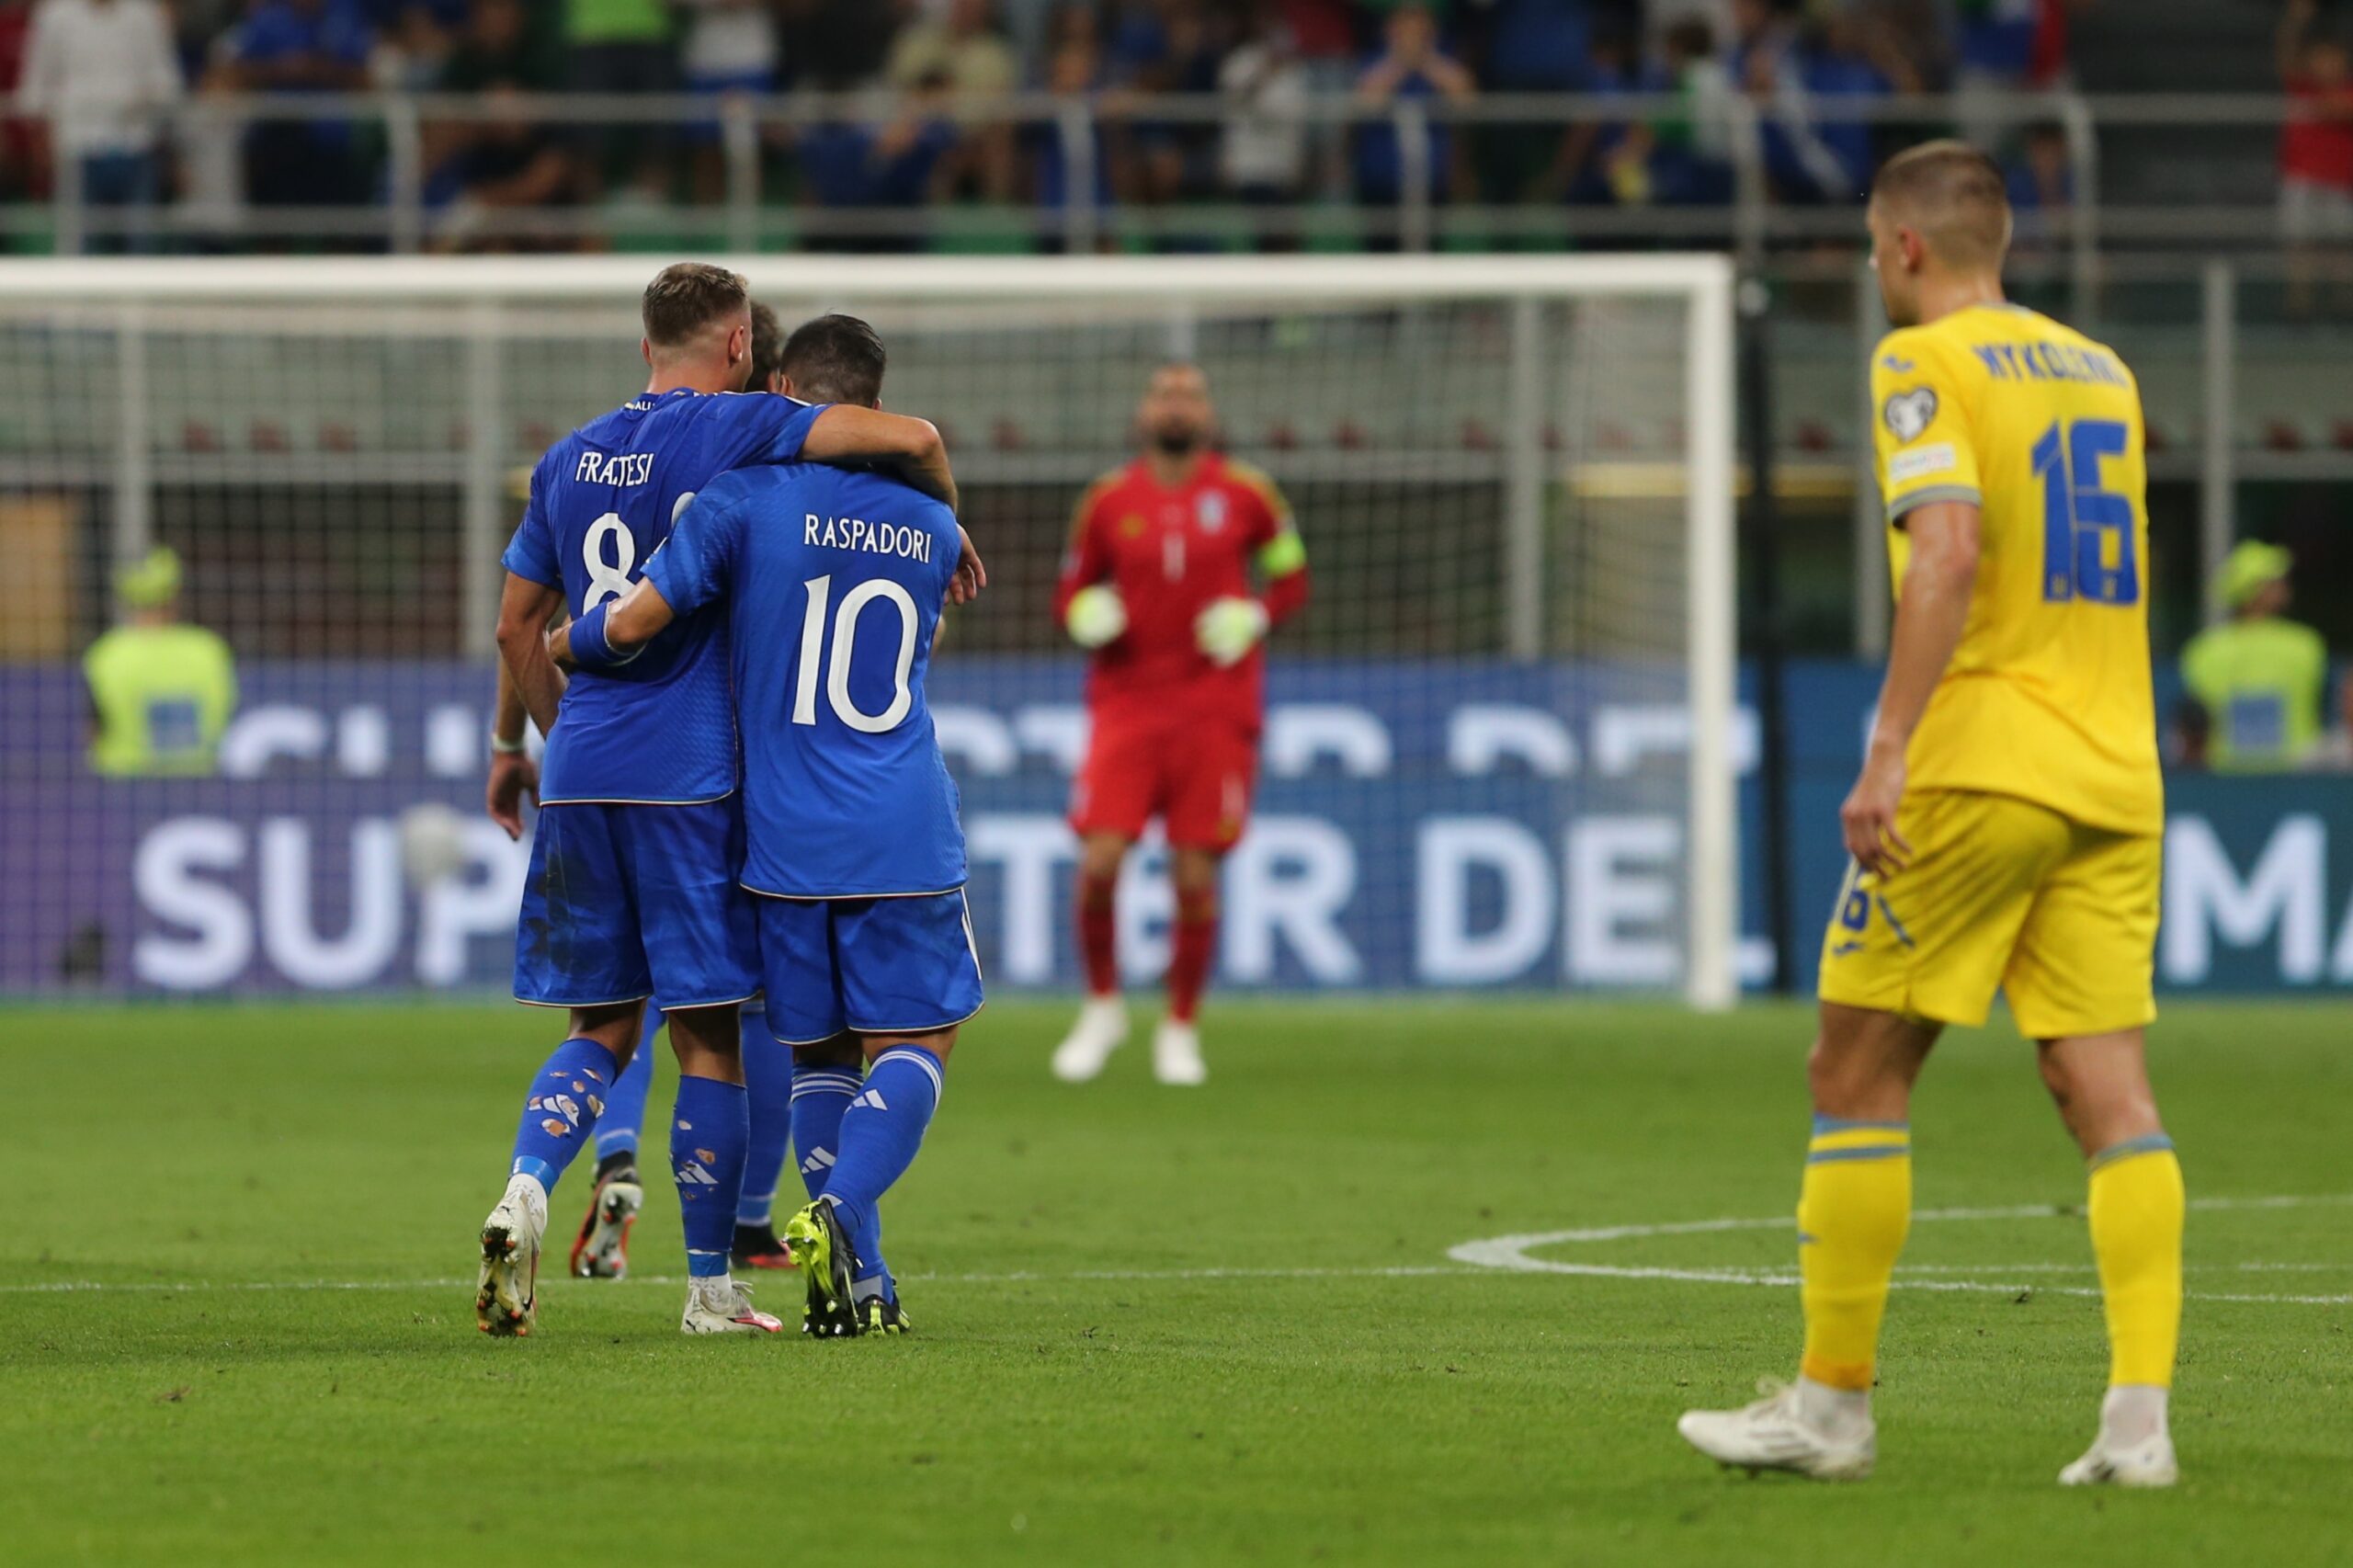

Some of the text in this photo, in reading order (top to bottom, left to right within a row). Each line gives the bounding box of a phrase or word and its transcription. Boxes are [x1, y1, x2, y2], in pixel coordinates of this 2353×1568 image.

[583, 512, 636, 617] 8
[803, 513, 932, 564] RASPADORI
[2030, 417, 2140, 608] 16
[791, 574, 918, 733] 10
